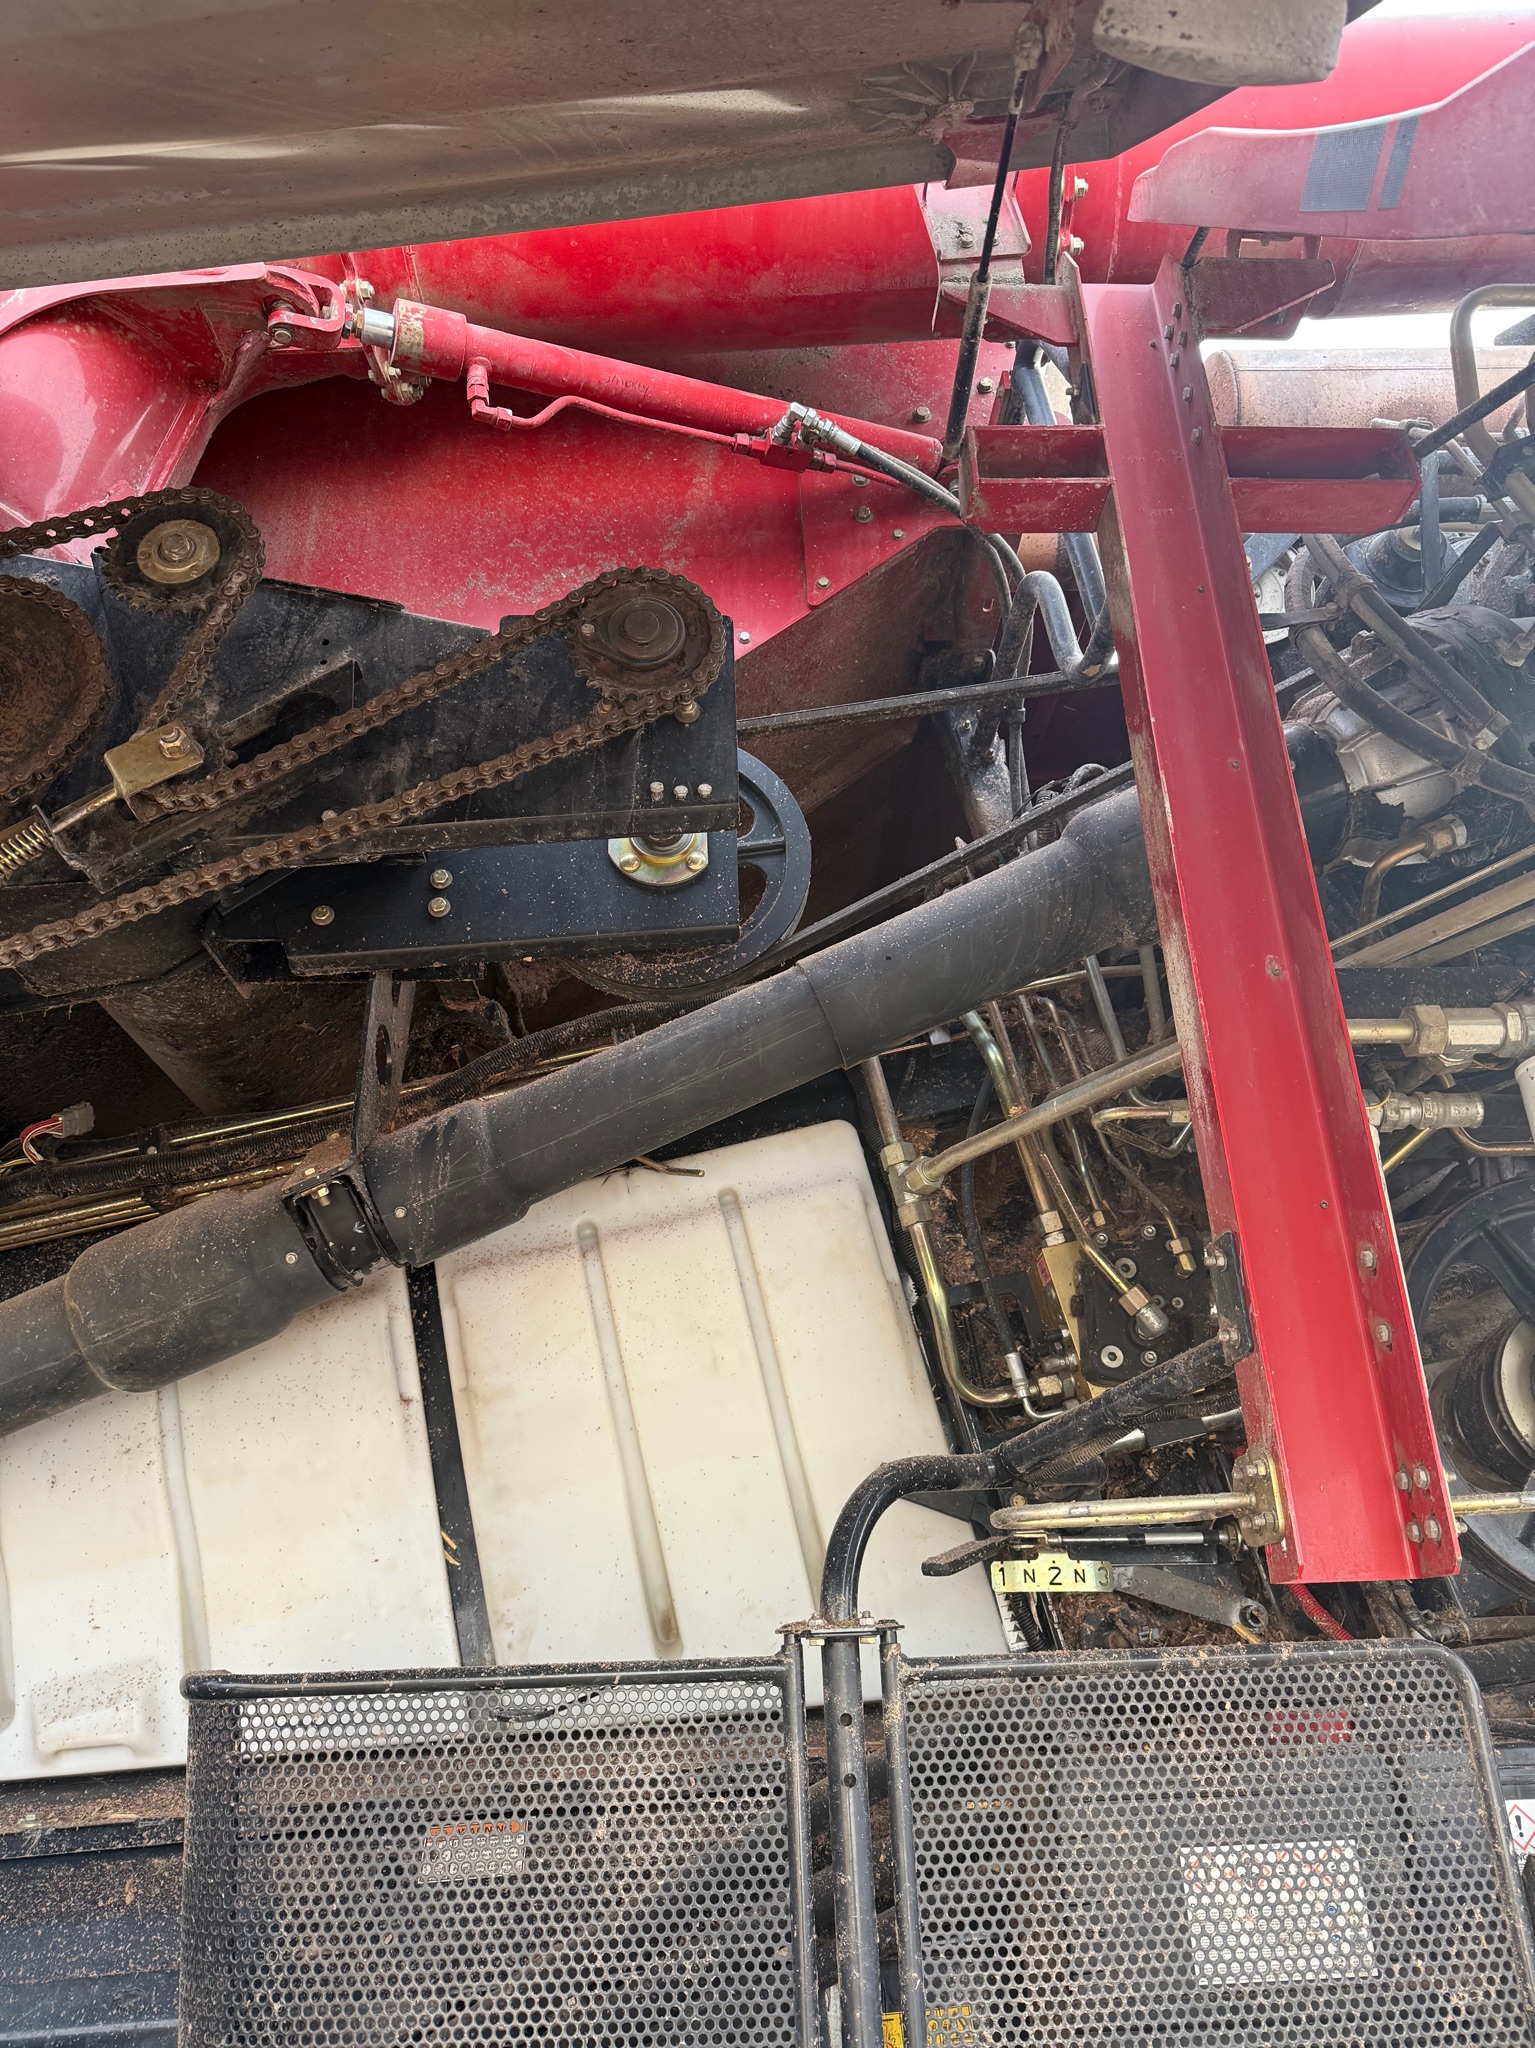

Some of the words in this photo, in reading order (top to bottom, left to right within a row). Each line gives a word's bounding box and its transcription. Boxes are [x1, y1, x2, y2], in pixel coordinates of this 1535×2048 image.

[998, 1566, 1006, 1587] 1
[1023, 1568, 1036, 1584] N
[1047, 1566, 1063, 1586] 2
[1073, 1568, 1086, 1584] N
[1097, 1565, 1110, 1587] 3
